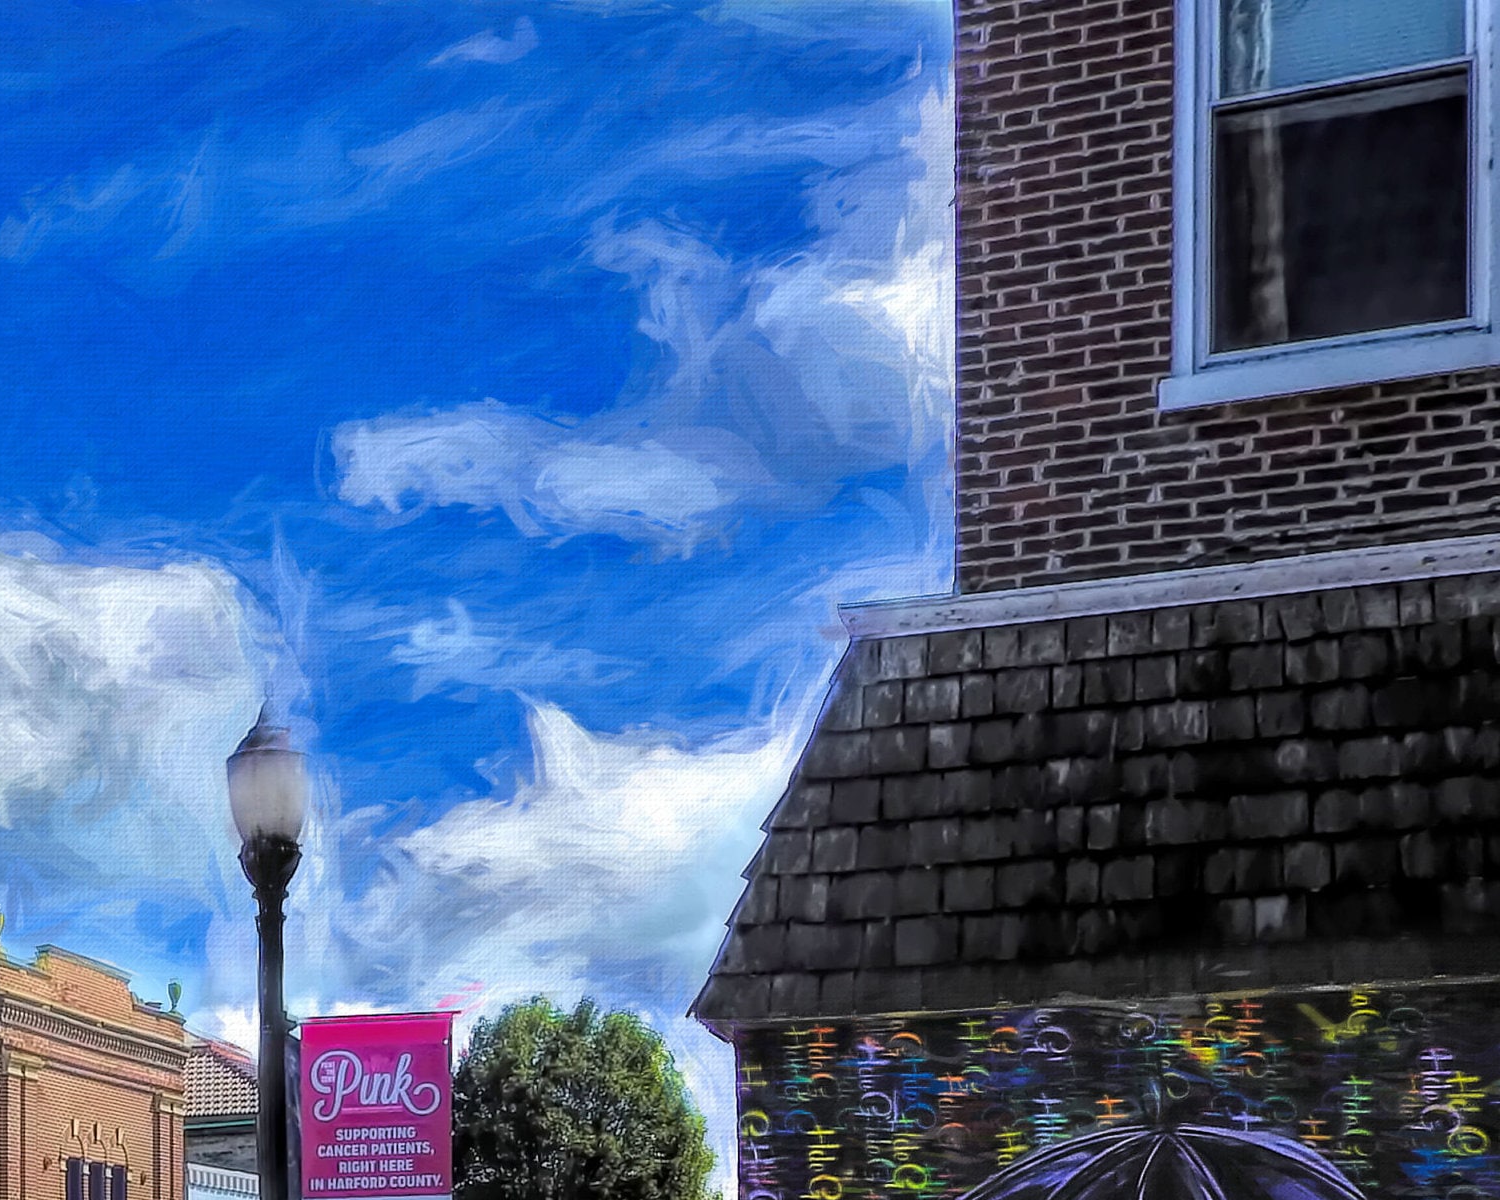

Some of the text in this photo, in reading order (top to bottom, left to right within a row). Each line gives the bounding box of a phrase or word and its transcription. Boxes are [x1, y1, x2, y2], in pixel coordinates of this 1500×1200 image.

[310, 1049, 441, 1122] Pink
[335, 1126, 416, 1141] SUPPORTING
[317, 1141, 436, 1158] CANCER PATIENTS,
[338, 1159, 414, 1174] RIGHT HERE
[310, 1174, 444, 1191] IN HARFORD COUNTY.
